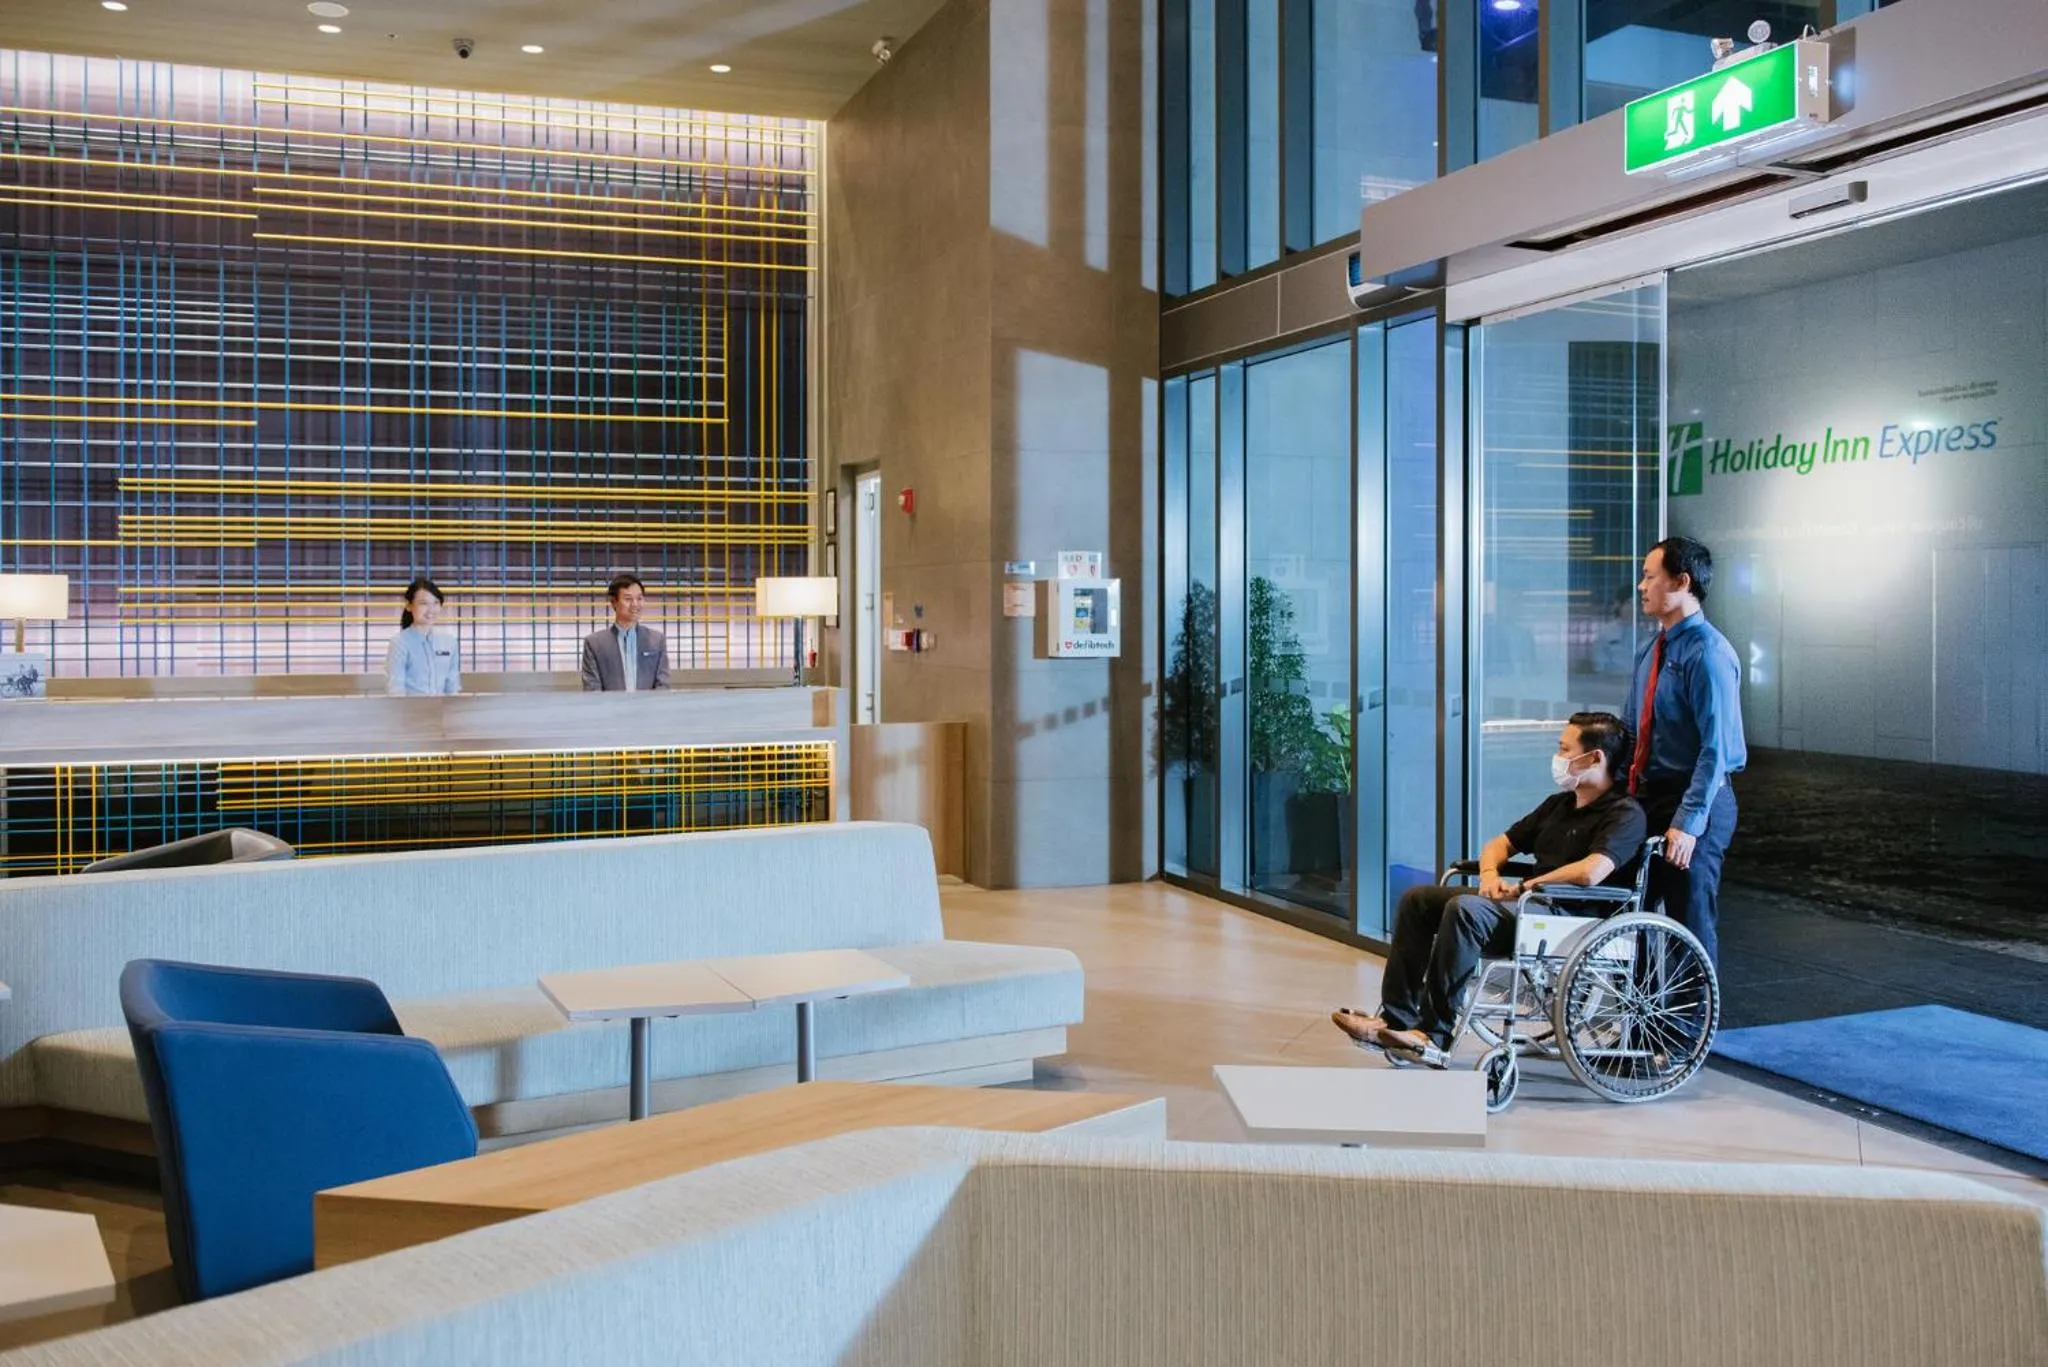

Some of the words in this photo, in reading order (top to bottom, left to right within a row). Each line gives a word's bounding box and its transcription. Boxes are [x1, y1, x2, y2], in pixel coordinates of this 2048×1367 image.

[1710, 433, 1817, 475] Holiday
[1823, 427, 1870, 463] Inn
[1879, 420, 1998, 464] Express
